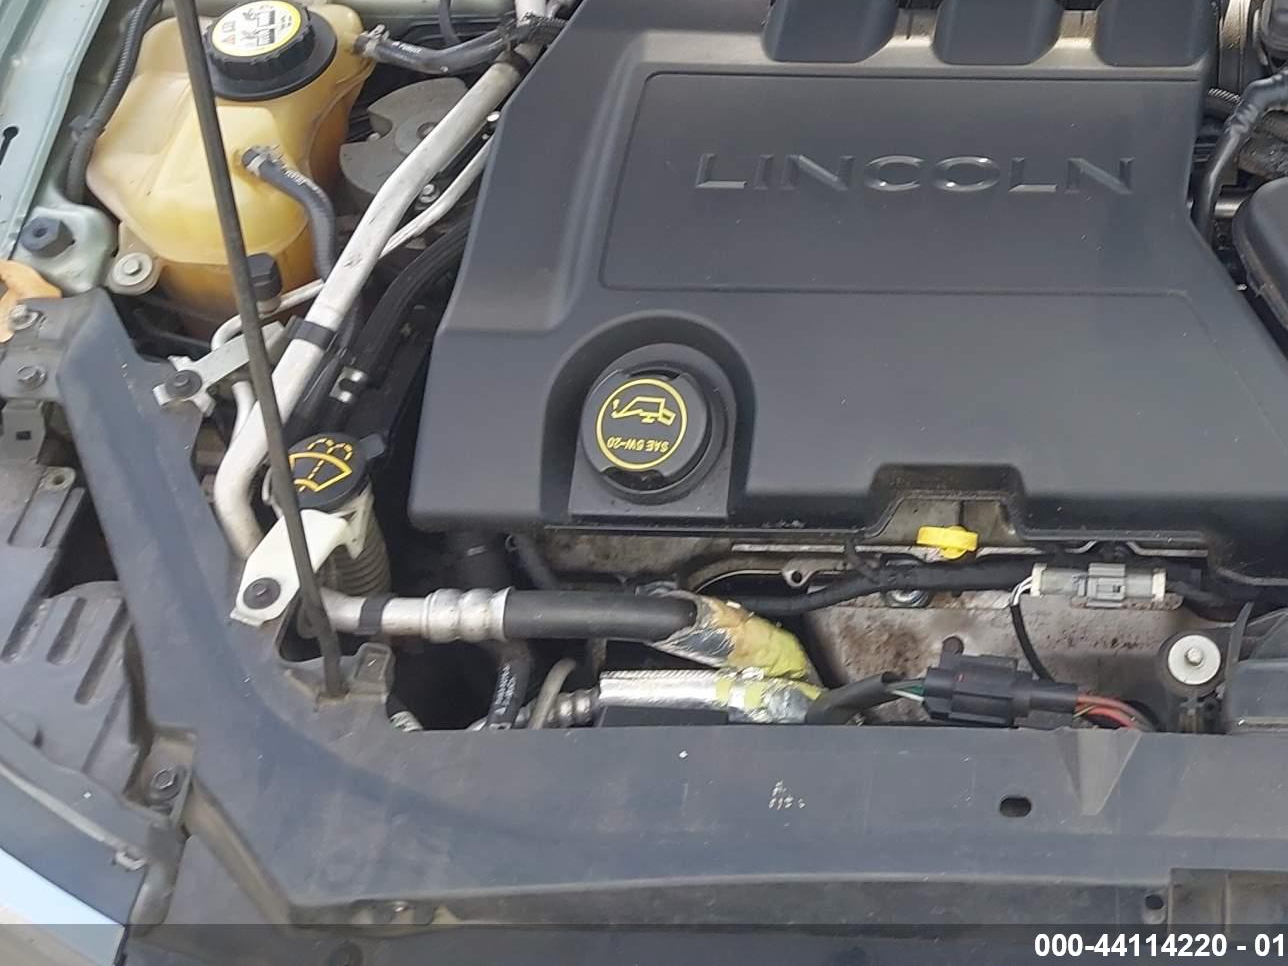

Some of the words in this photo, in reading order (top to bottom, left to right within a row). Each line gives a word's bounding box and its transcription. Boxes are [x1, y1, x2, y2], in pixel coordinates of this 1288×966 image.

[694, 153, 1136, 194] LINCOLN
[607, 436, 645, 451] 5W-20
[646, 440, 669, 452] SAE
